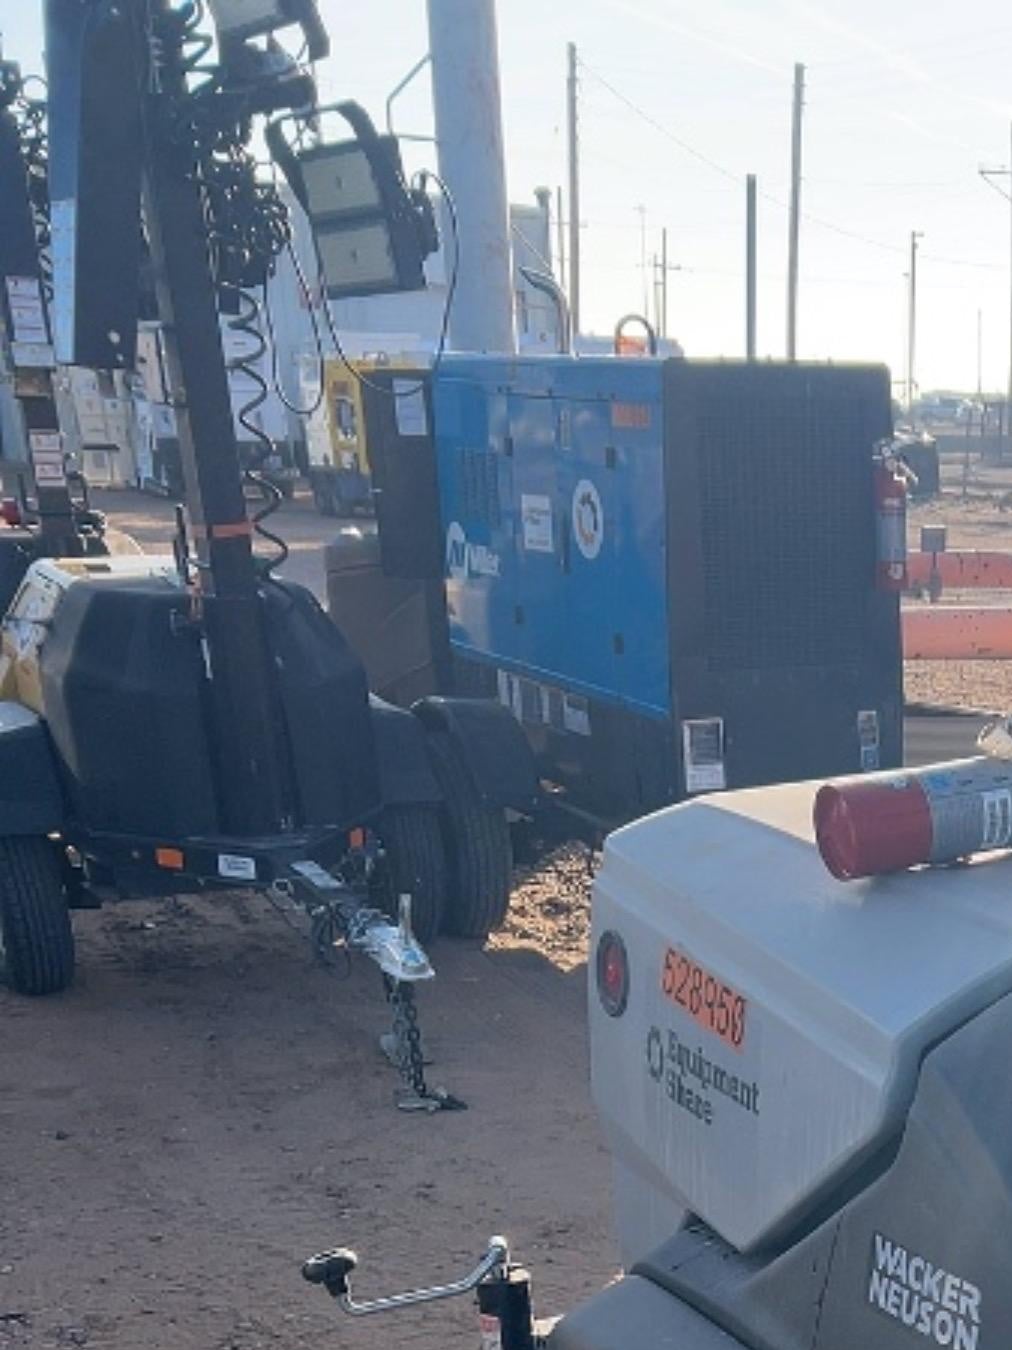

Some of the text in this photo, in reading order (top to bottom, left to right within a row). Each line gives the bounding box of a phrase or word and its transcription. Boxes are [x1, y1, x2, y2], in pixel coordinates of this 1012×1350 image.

[661, 946, 747, 1048] 528950
[665, 1069, 714, 1126] Share
[667, 1028, 761, 1116] Equipment
[875, 1233, 983, 1324] WACKER
